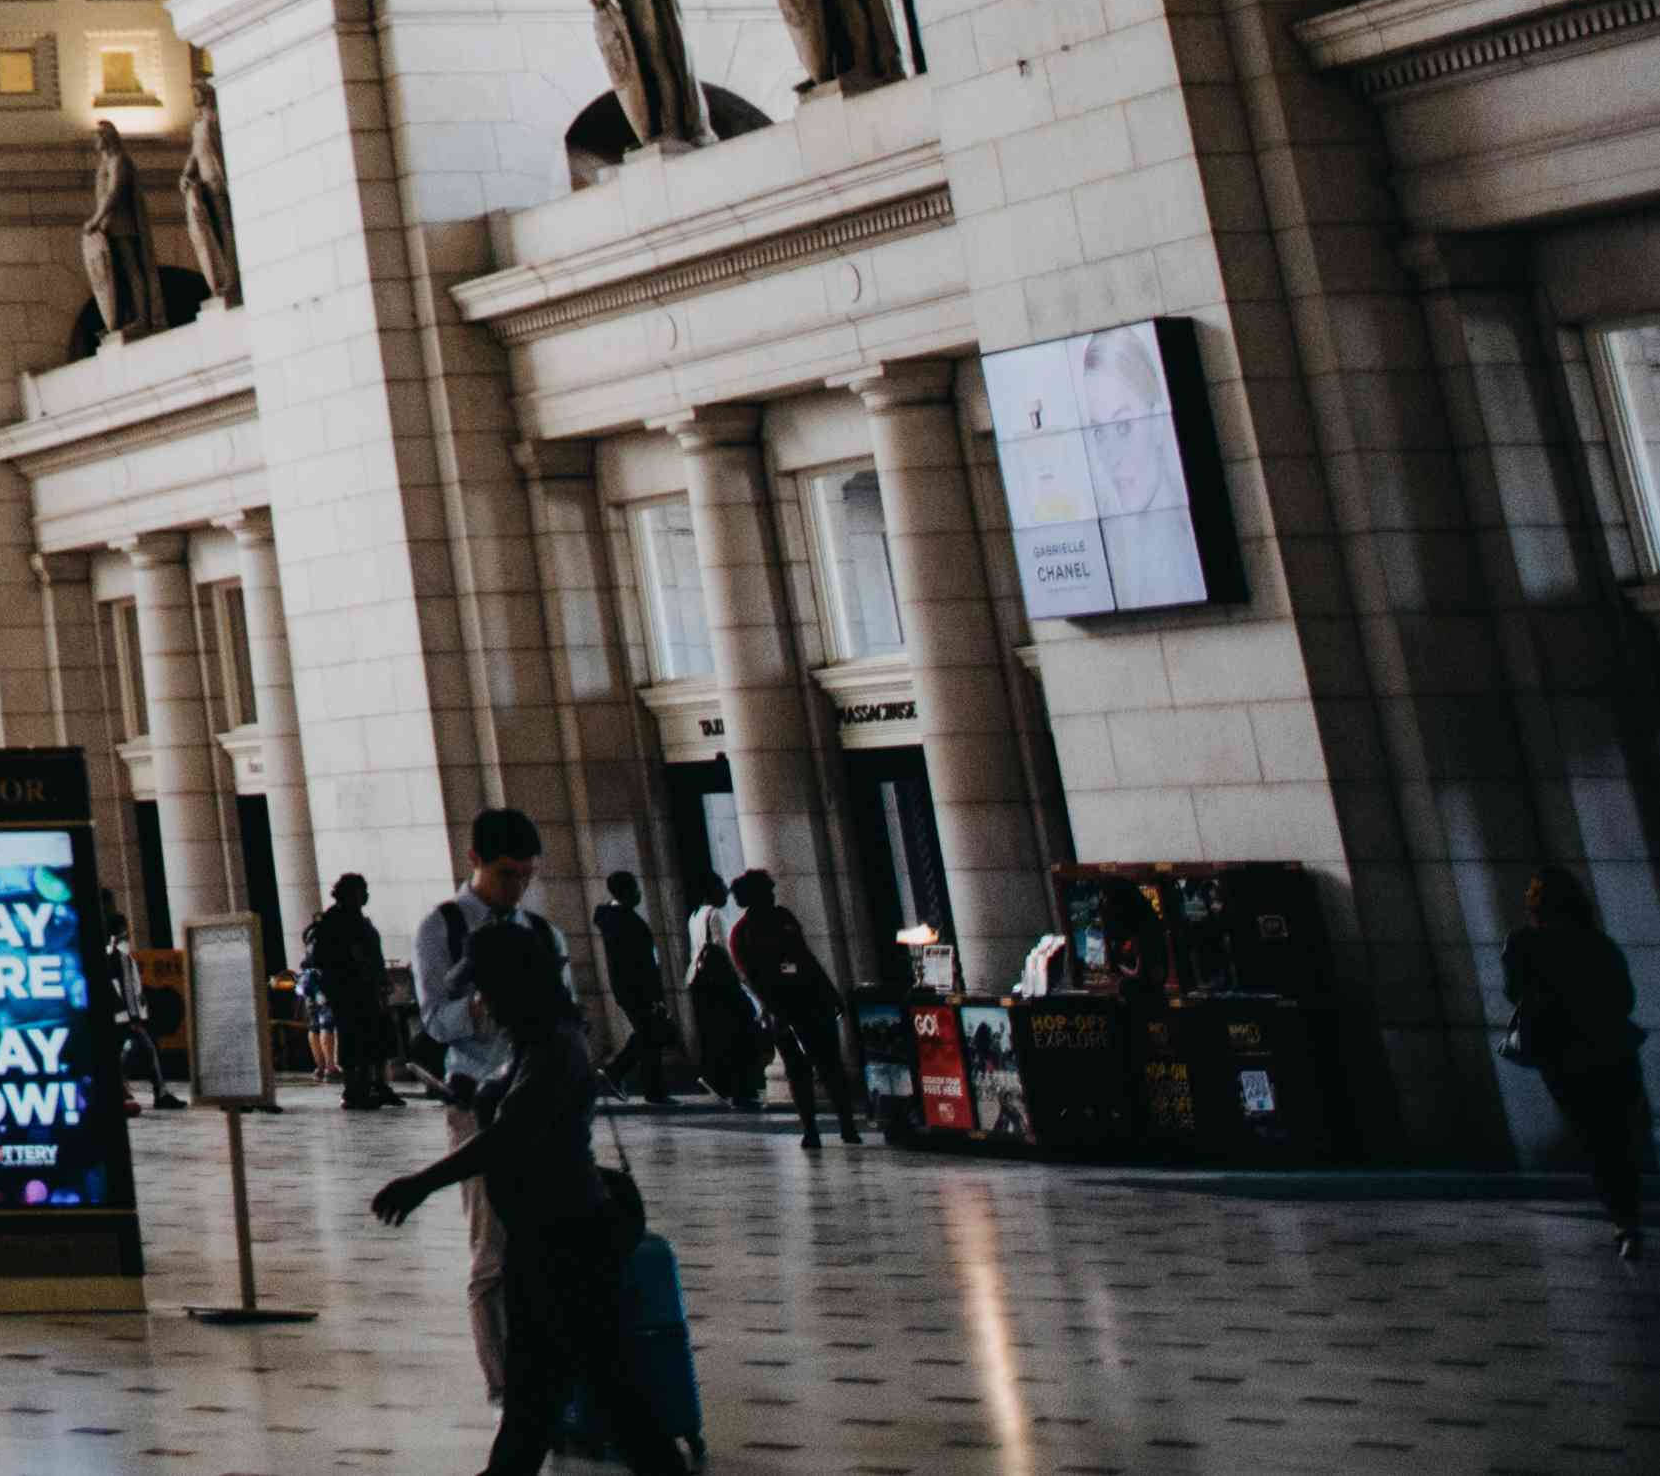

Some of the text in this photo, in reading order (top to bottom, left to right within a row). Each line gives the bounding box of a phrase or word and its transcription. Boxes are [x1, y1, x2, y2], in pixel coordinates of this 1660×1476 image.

[1033, 540, 1086, 558] GABRIELLE
[1037, 562, 1091, 582] CHANEL
[914, 1014, 940, 1037] GO!
